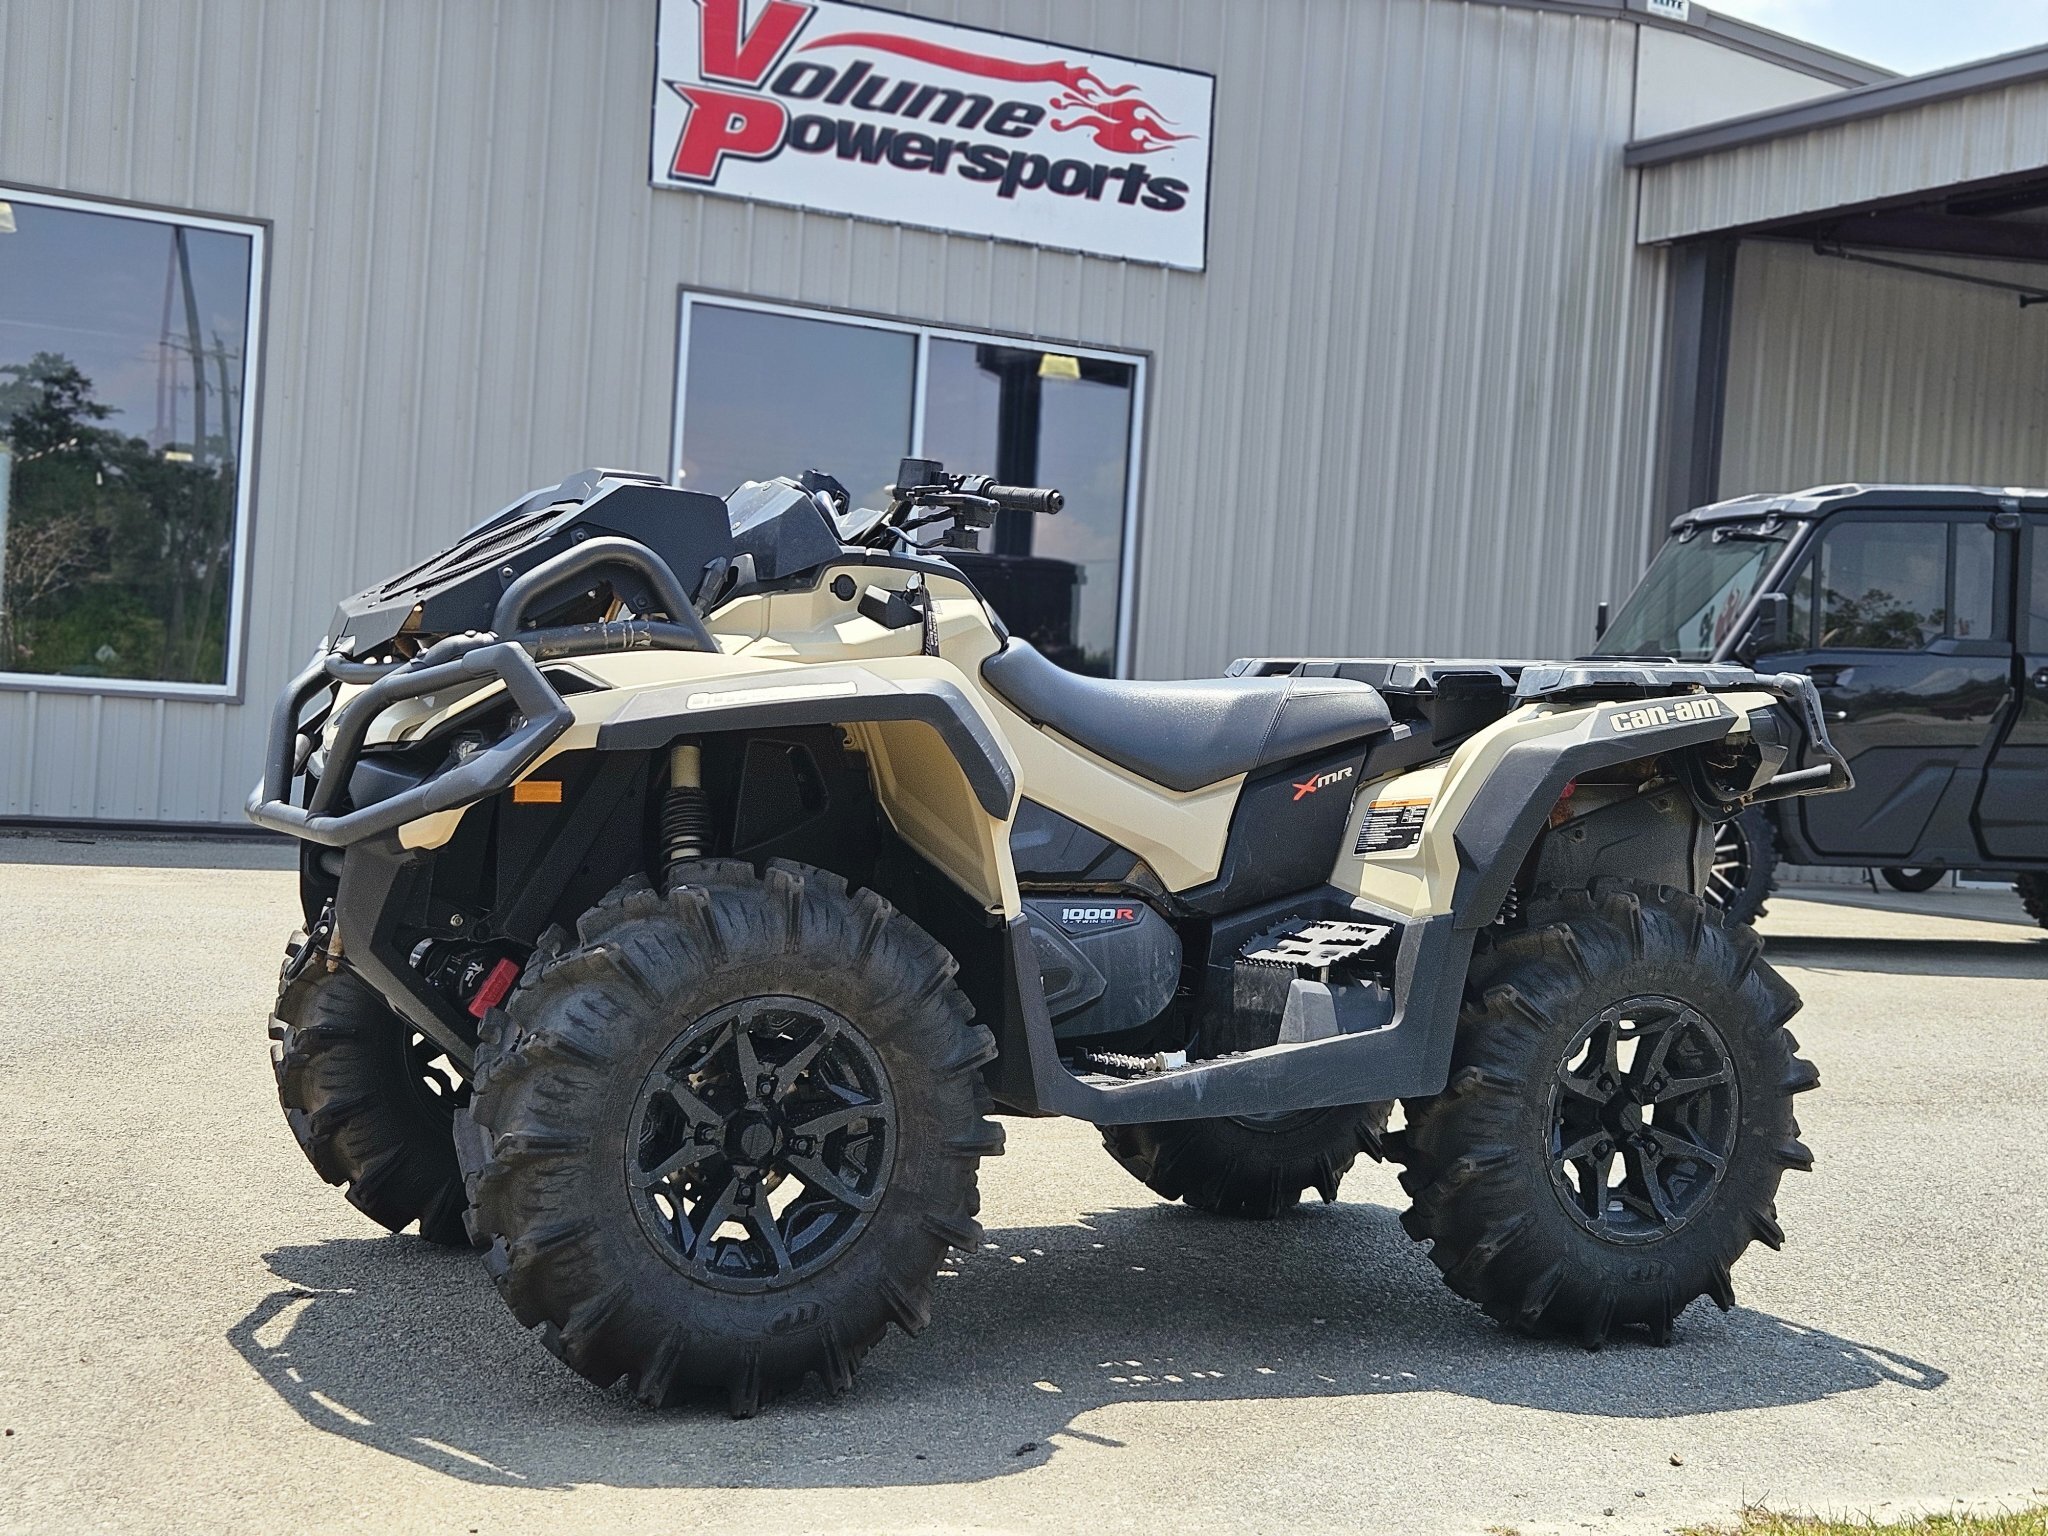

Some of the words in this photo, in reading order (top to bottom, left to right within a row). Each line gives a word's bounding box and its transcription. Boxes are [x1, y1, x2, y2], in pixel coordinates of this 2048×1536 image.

[692, 0, 1046, 137] Volume
[662, 78, 1189, 212] Powersports
[1609, 698, 1721, 732] can-am
[1292, 767, 1353, 801] XMR
[1062, 908, 1134, 920] 1000R
